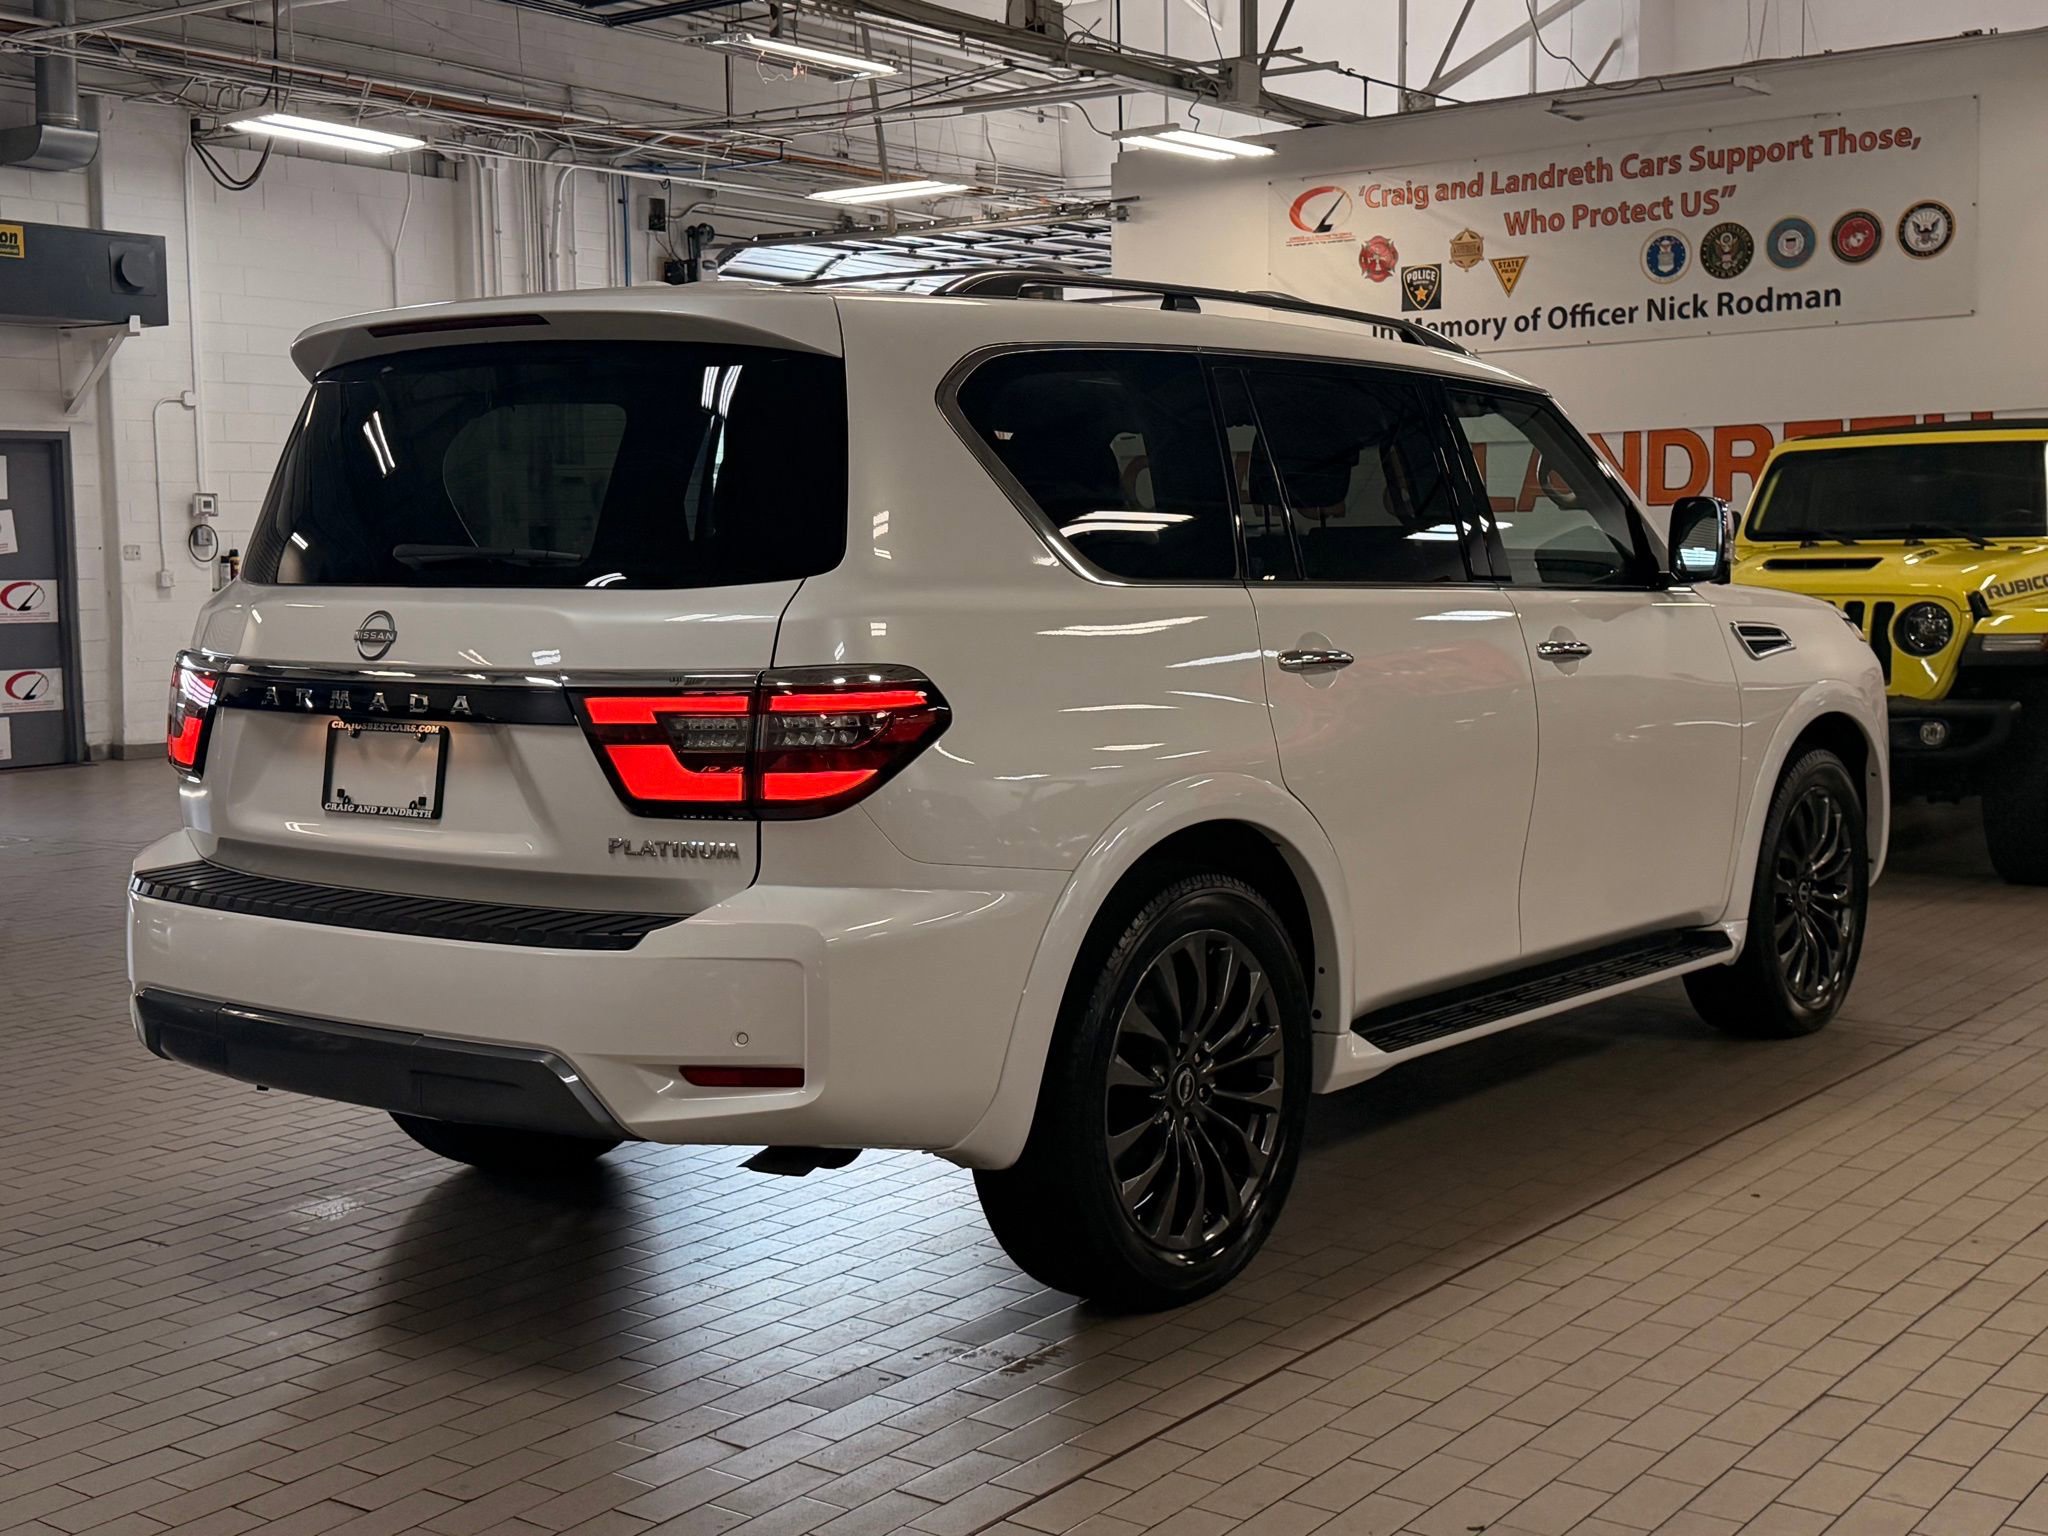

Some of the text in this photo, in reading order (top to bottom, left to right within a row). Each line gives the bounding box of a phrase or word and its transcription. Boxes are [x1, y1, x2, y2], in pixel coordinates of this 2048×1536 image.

[1436, 171, 1484, 201] and
[1491, 156, 1613, 195] Landreth
[1620, 153, 1682, 179] Cars
[1689, 134, 1814, 173] Support
[1819, 126, 1921, 156] Those,
[1504, 206, 1566, 237] Who
[1572, 196, 1674, 229] Protect
[1406, 270, 1436, 283] POLICE
[1498, 260, 1519, 269] STATE
[1403, 314, 1507, 342] emory
[1514, 306, 1541, 333] of
[1548, 301, 1639, 329] Officer
[1647, 297, 1708, 322] Nick
[1717, 286, 1842, 315] Rodman
[261, 686, 473, 715] ARMADA
[325, 802, 433, 818] CRAIG AND LANDRETH
[608, 837, 740, 860] PLATINUM
